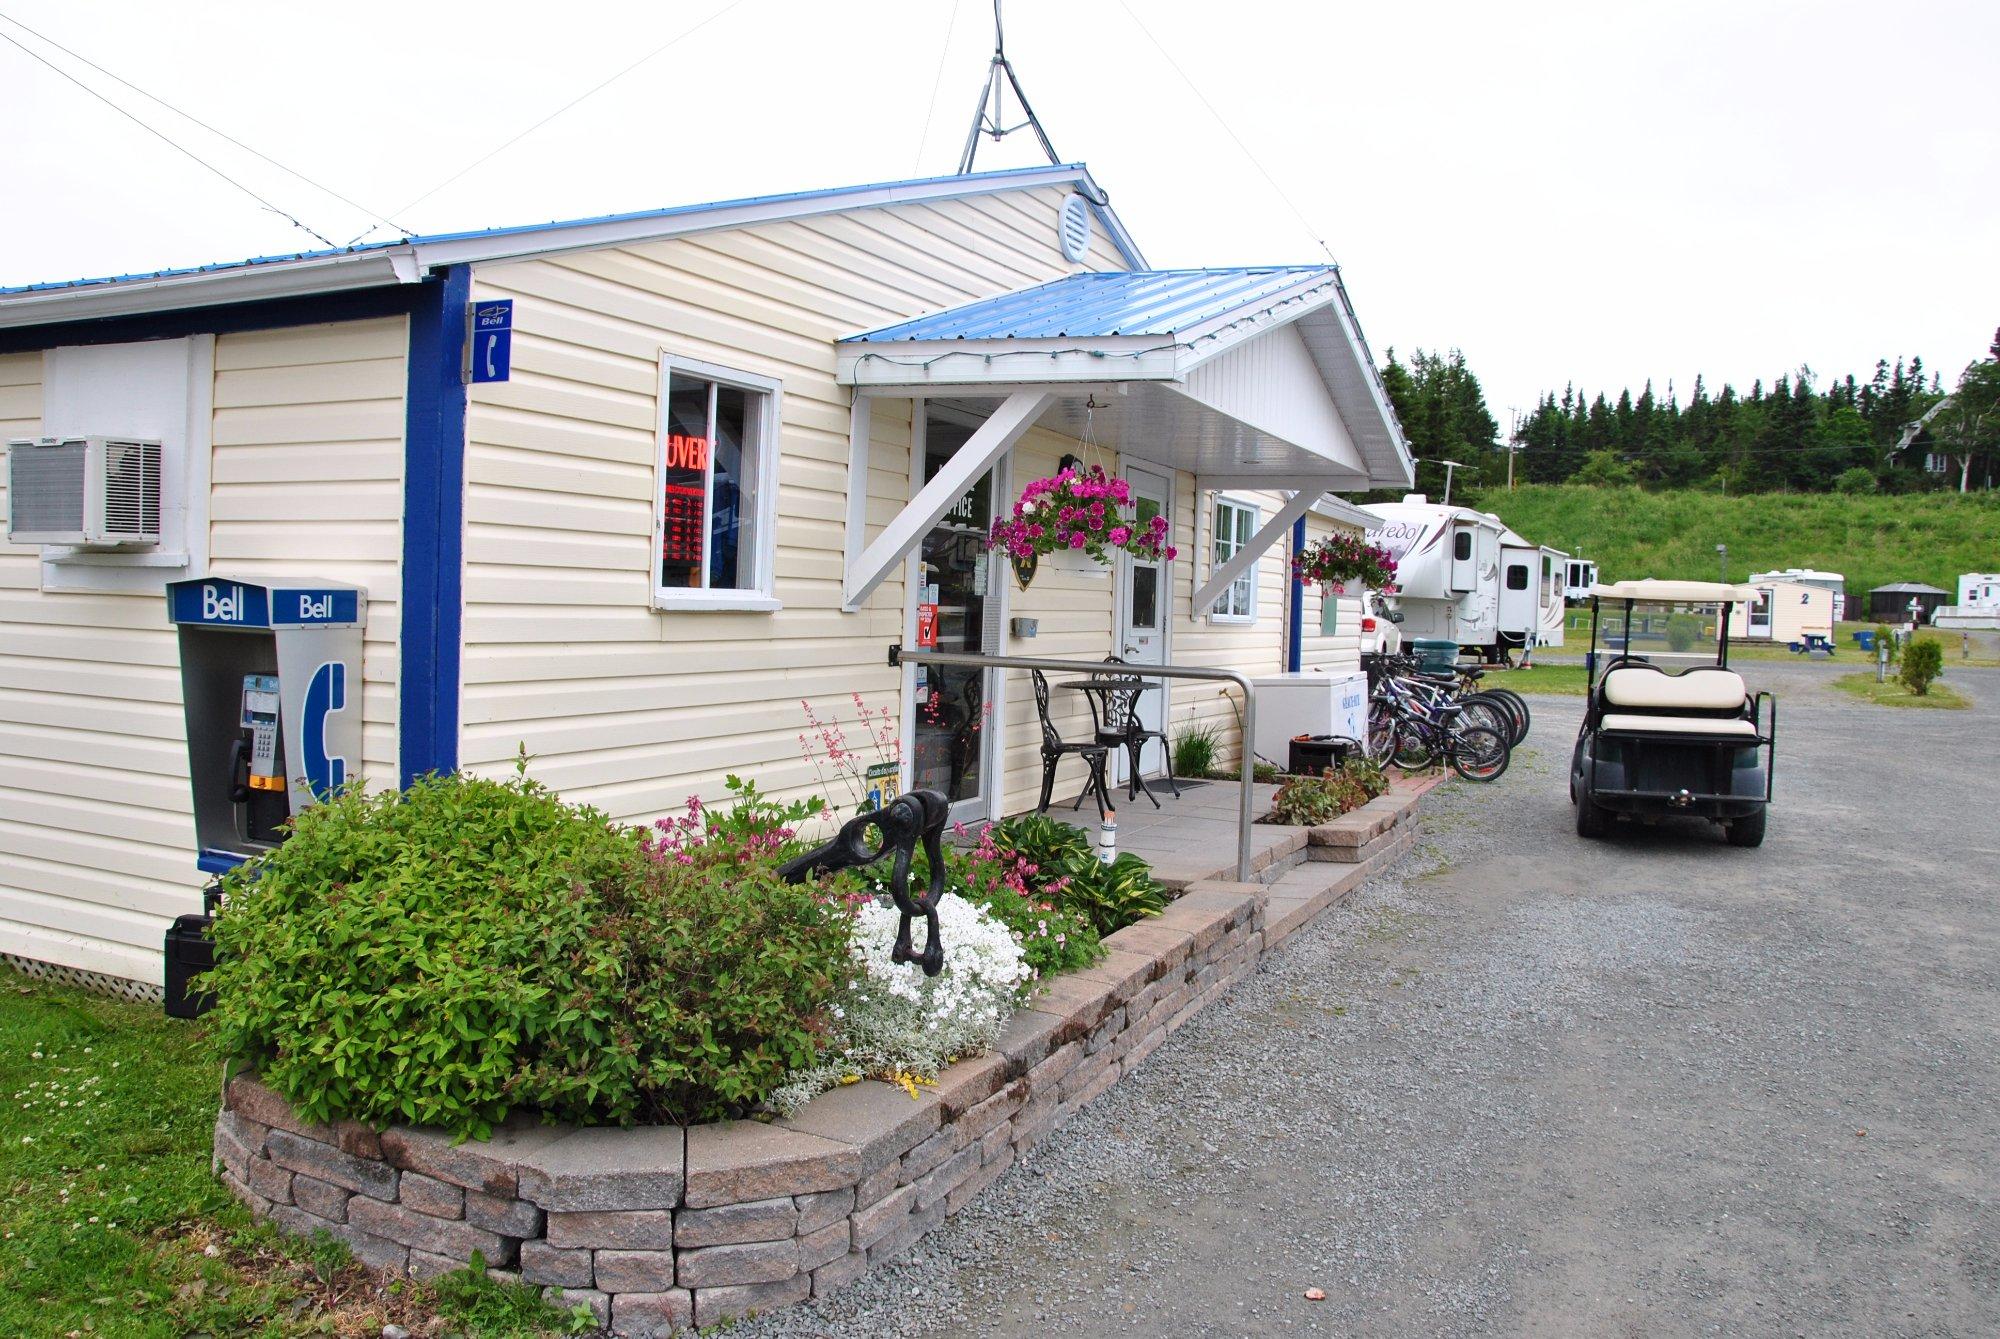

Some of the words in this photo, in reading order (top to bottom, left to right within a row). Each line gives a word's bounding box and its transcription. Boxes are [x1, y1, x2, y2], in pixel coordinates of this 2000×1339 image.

[481, 316, 504, 326] Bell
[666, 434, 708, 470] UVER
[203, 584, 244, 621] Bell
[300, 594, 333, 619] Bell
[1801, 593, 1810, 605] 2
